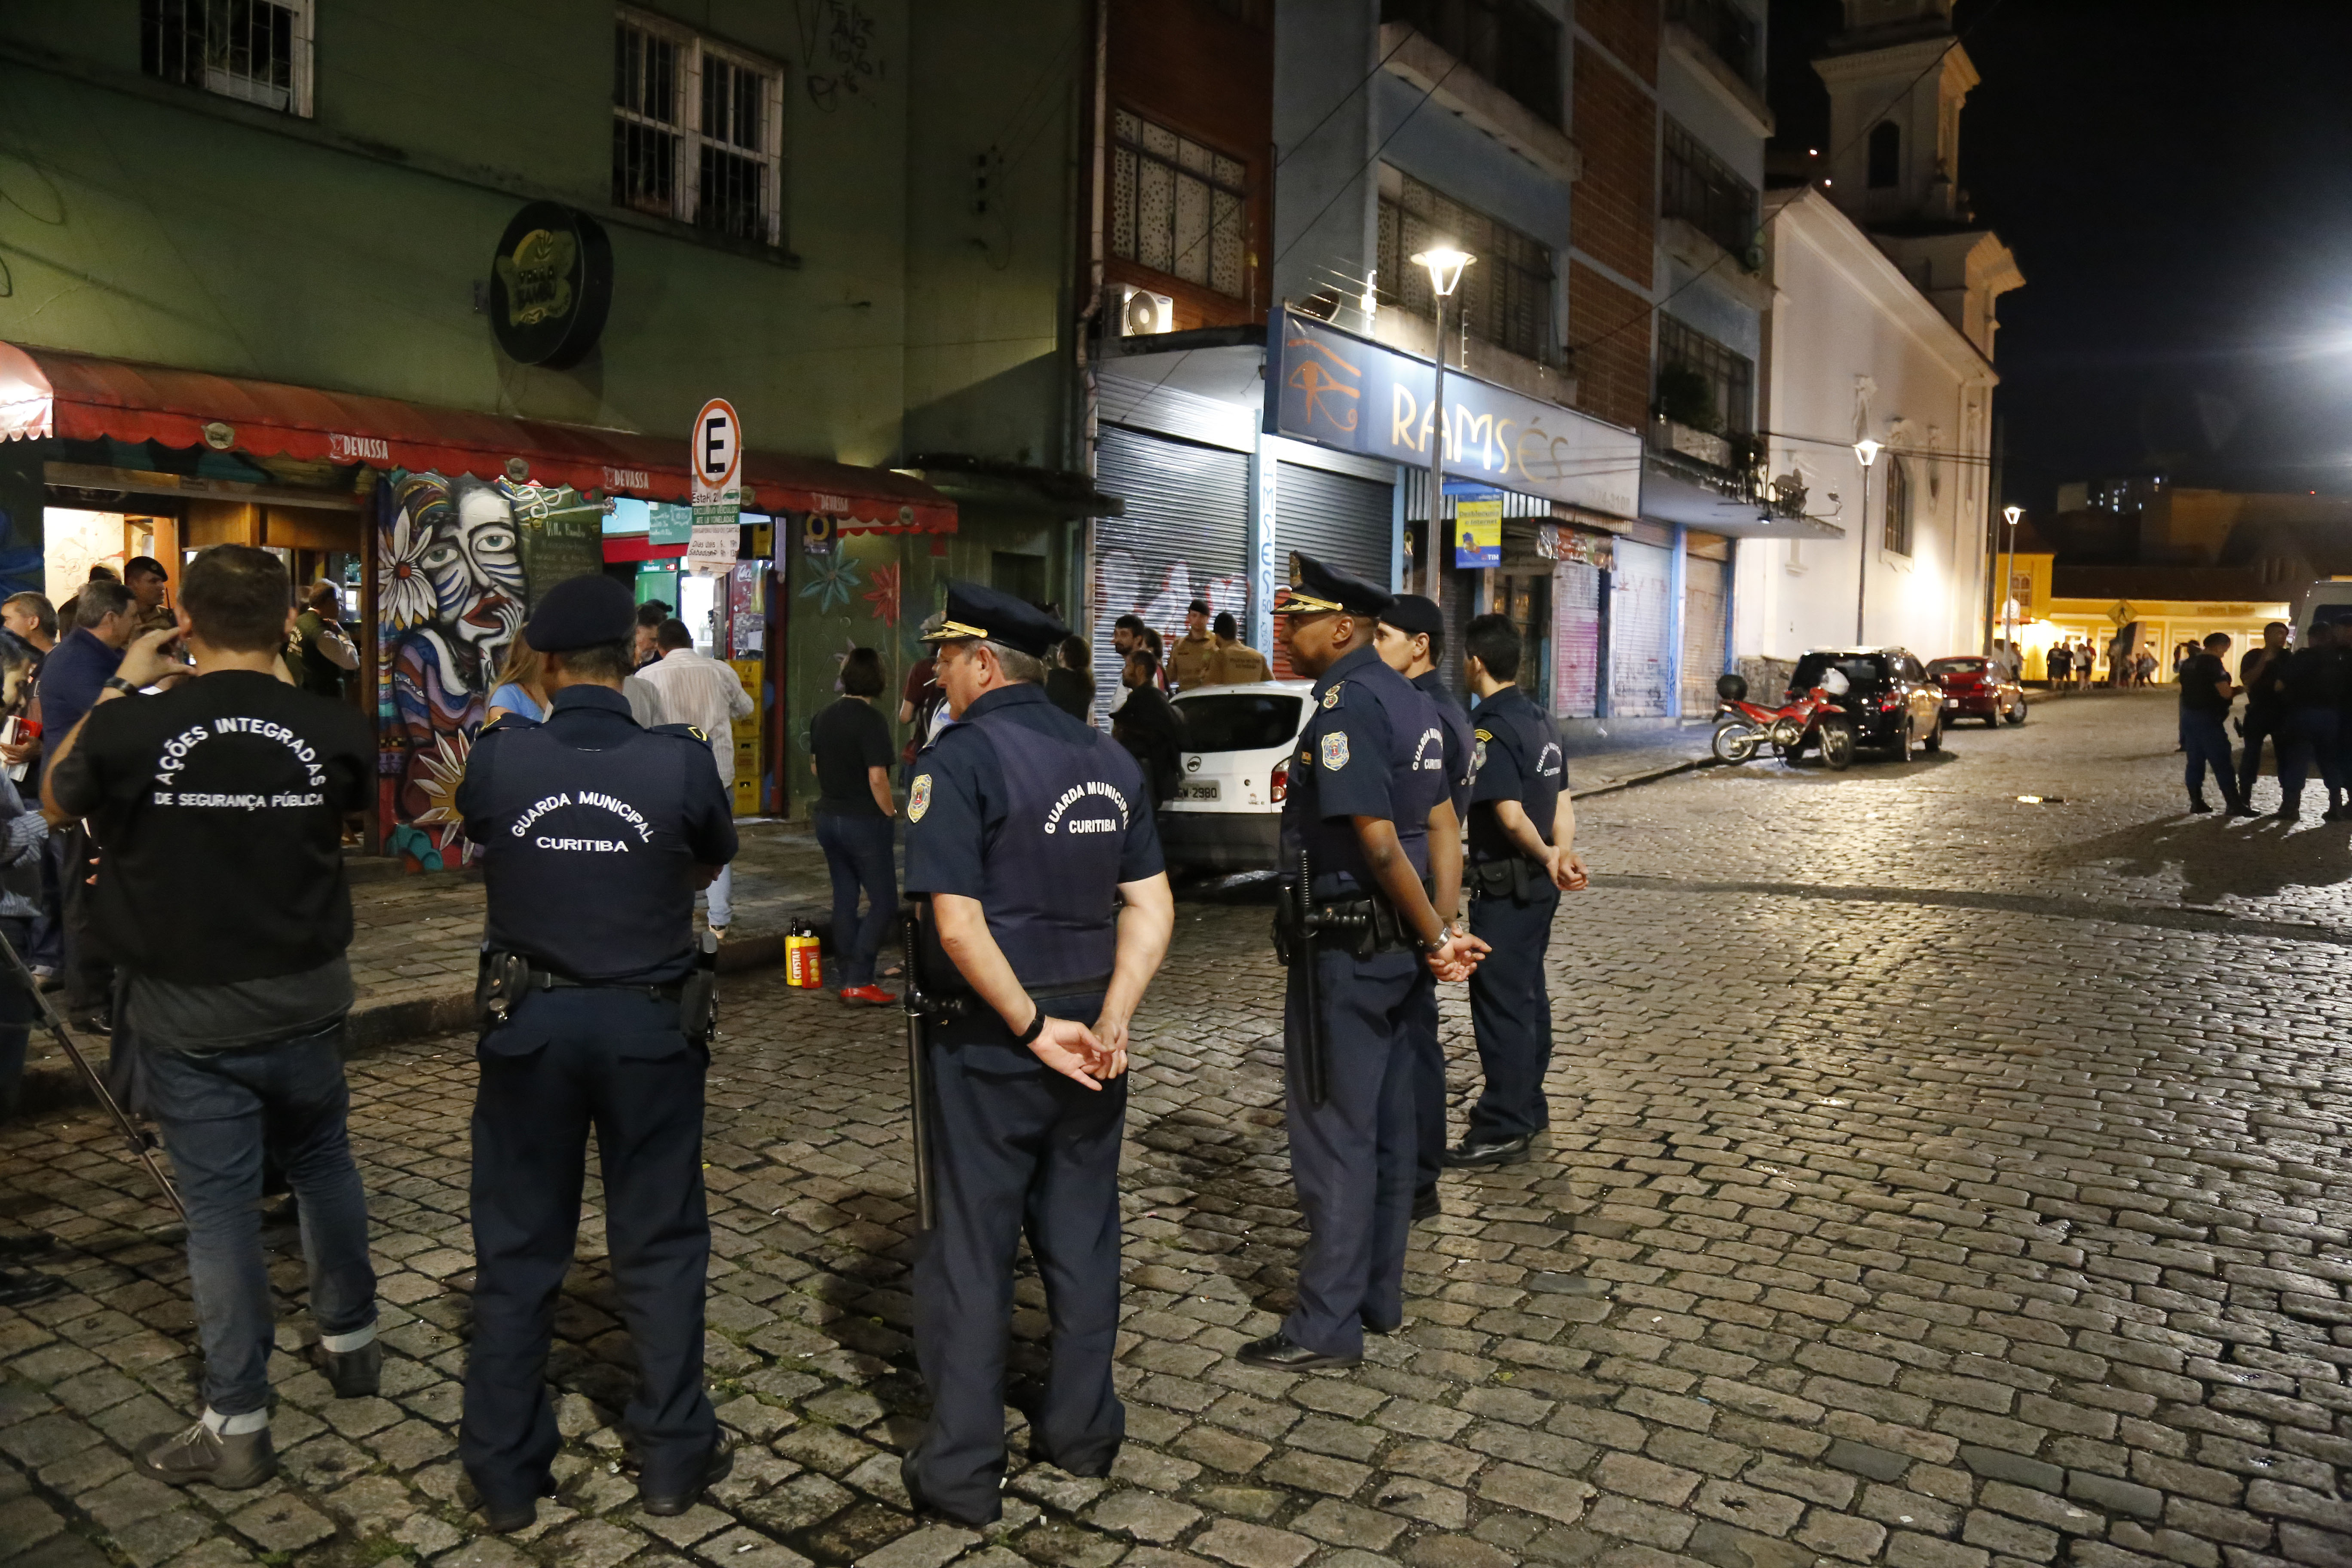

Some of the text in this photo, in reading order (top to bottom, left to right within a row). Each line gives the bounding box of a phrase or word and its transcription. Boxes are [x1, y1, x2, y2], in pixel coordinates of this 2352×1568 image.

[344, 436, 389, 459] DEVASSA
[706, 417, 726, 473] E
[1392, 383, 1568, 488] RAMSÉS
[615, 469, 649, 489] DEVASSA
[821, 495, 848, 512] DEVASSA
[156, 717, 326, 786] AÇÕES INTEGRADAS
[1412, 729, 1431, 771] GUARDA
[154, 791, 323, 811] DE SEGURANÇA PÚBLICA
[511, 791, 654, 843] GUARDA MUNICIPAL
[1044, 781, 1129, 834] GUARDA MUNICIPAL
[1069, 819, 1117, 834] CURITIBA
[536, 836, 629, 852] CURITIBA
